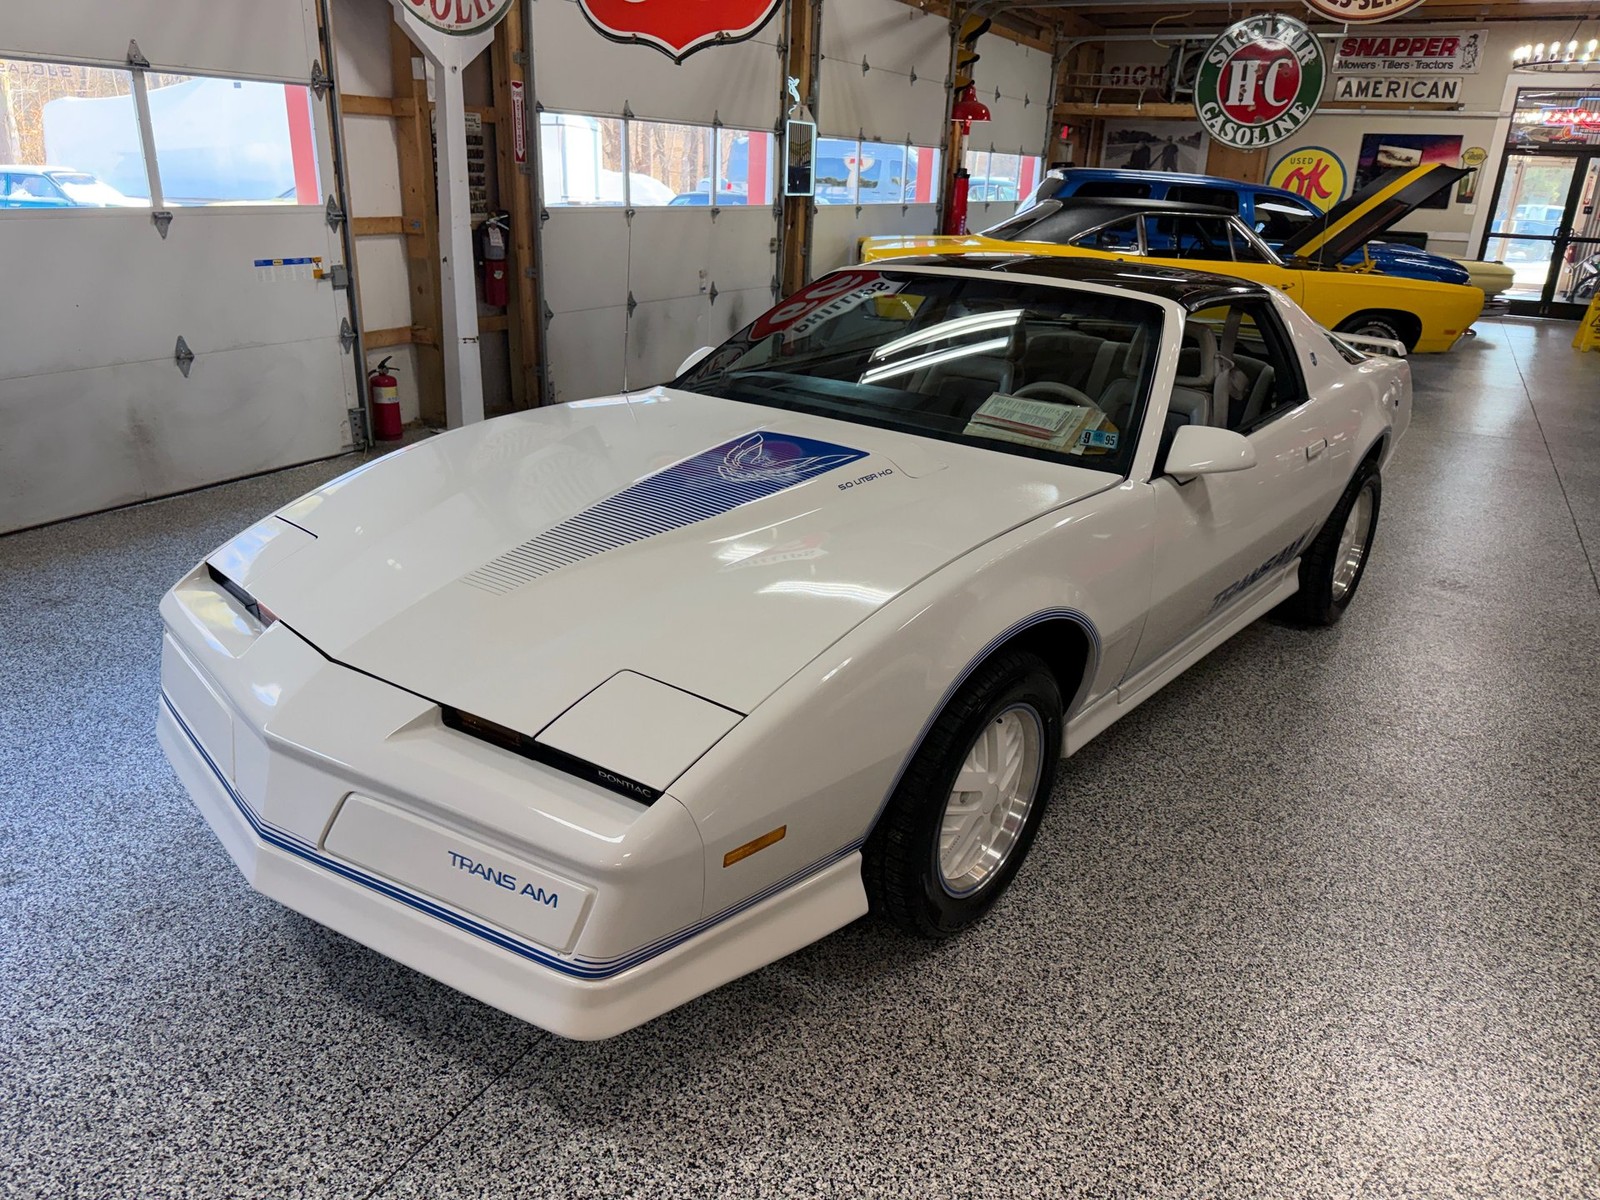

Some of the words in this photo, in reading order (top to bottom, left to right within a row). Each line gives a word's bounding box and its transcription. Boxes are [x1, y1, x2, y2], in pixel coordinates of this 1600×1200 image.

[1208, 19, 1318, 67] SINCLAIR
[1339, 37, 1460, 57] SNAPPER
[1337, 59, 1376, 70] Mowers
[1381, 60, 1410, 70] Tillers
[1415, 60, 1454, 70] Tractors
[1340, 81, 1458, 99] AMERICAN
[1201, 101, 1310, 145] GASOLINE
[1290, 157, 1314, 165] USED
[1281, 158, 1332, 199] OK
[1105, 435, 1116, 446] 95
[853, 473, 879, 486] LITER
[598, 770, 652, 798] PONTIAC
[448, 850, 517, 891] TRANS
[519, 883, 558, 909] AM
